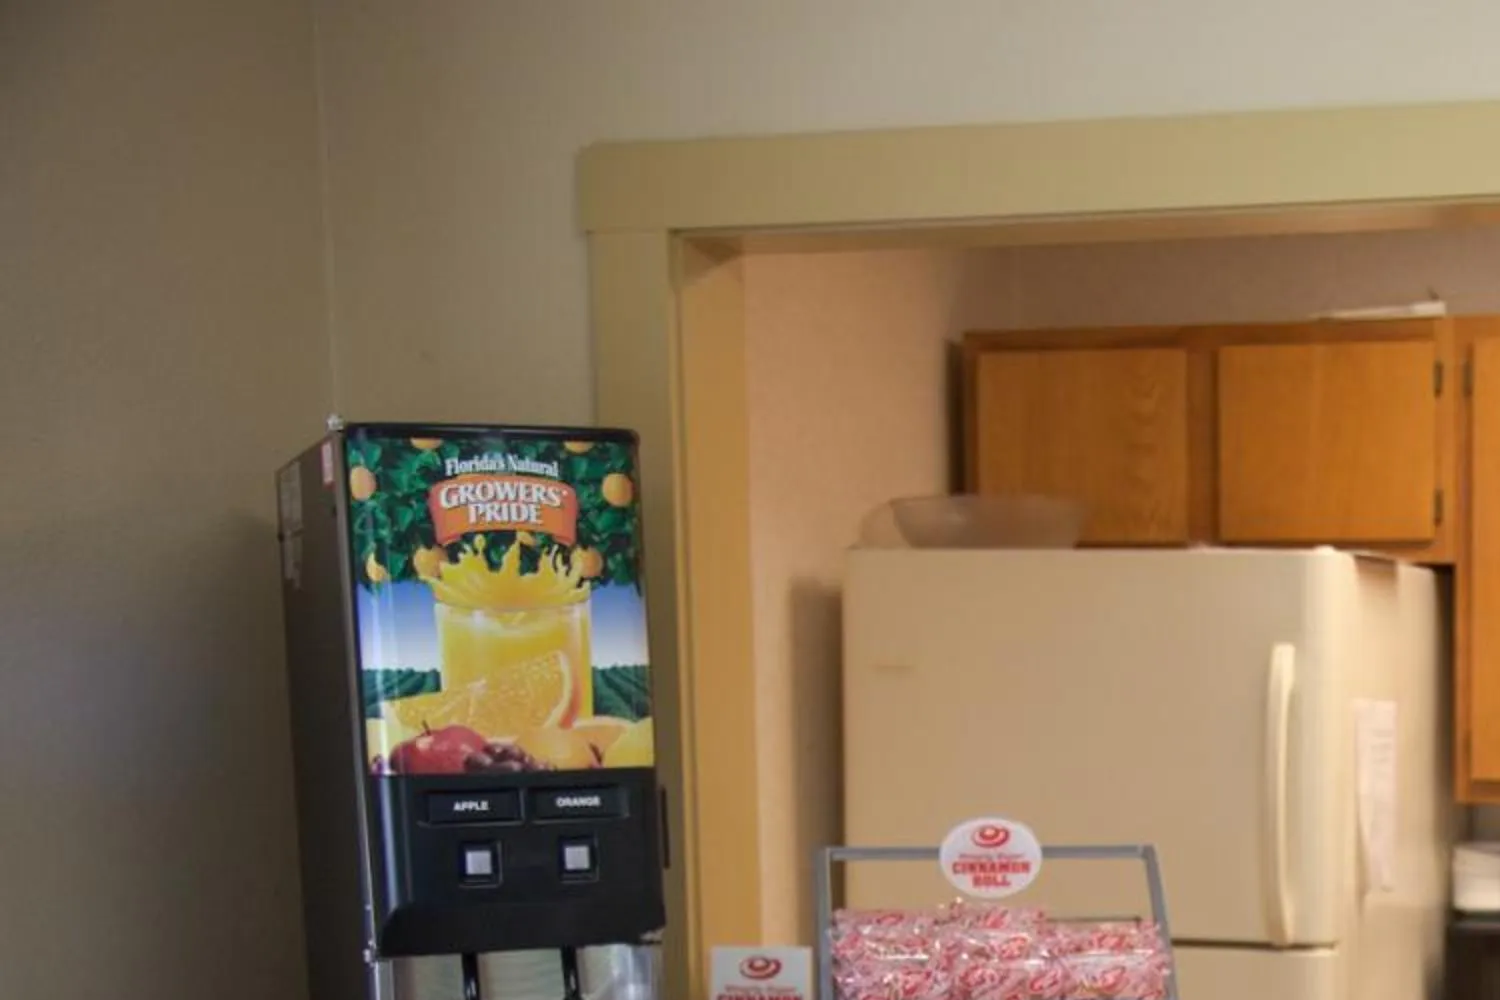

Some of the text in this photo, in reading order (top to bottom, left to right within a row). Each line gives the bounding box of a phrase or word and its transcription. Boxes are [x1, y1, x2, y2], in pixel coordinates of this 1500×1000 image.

[445, 453, 559, 477] Florida's Natural
[467, 501, 543, 524] PRIDE
[453, 800, 489, 812] APPLE
[555, 796, 601, 808] ORANGE
[952, 861, 1031, 875] CINNAMON
[973, 874, 1011, 888] ROLL
